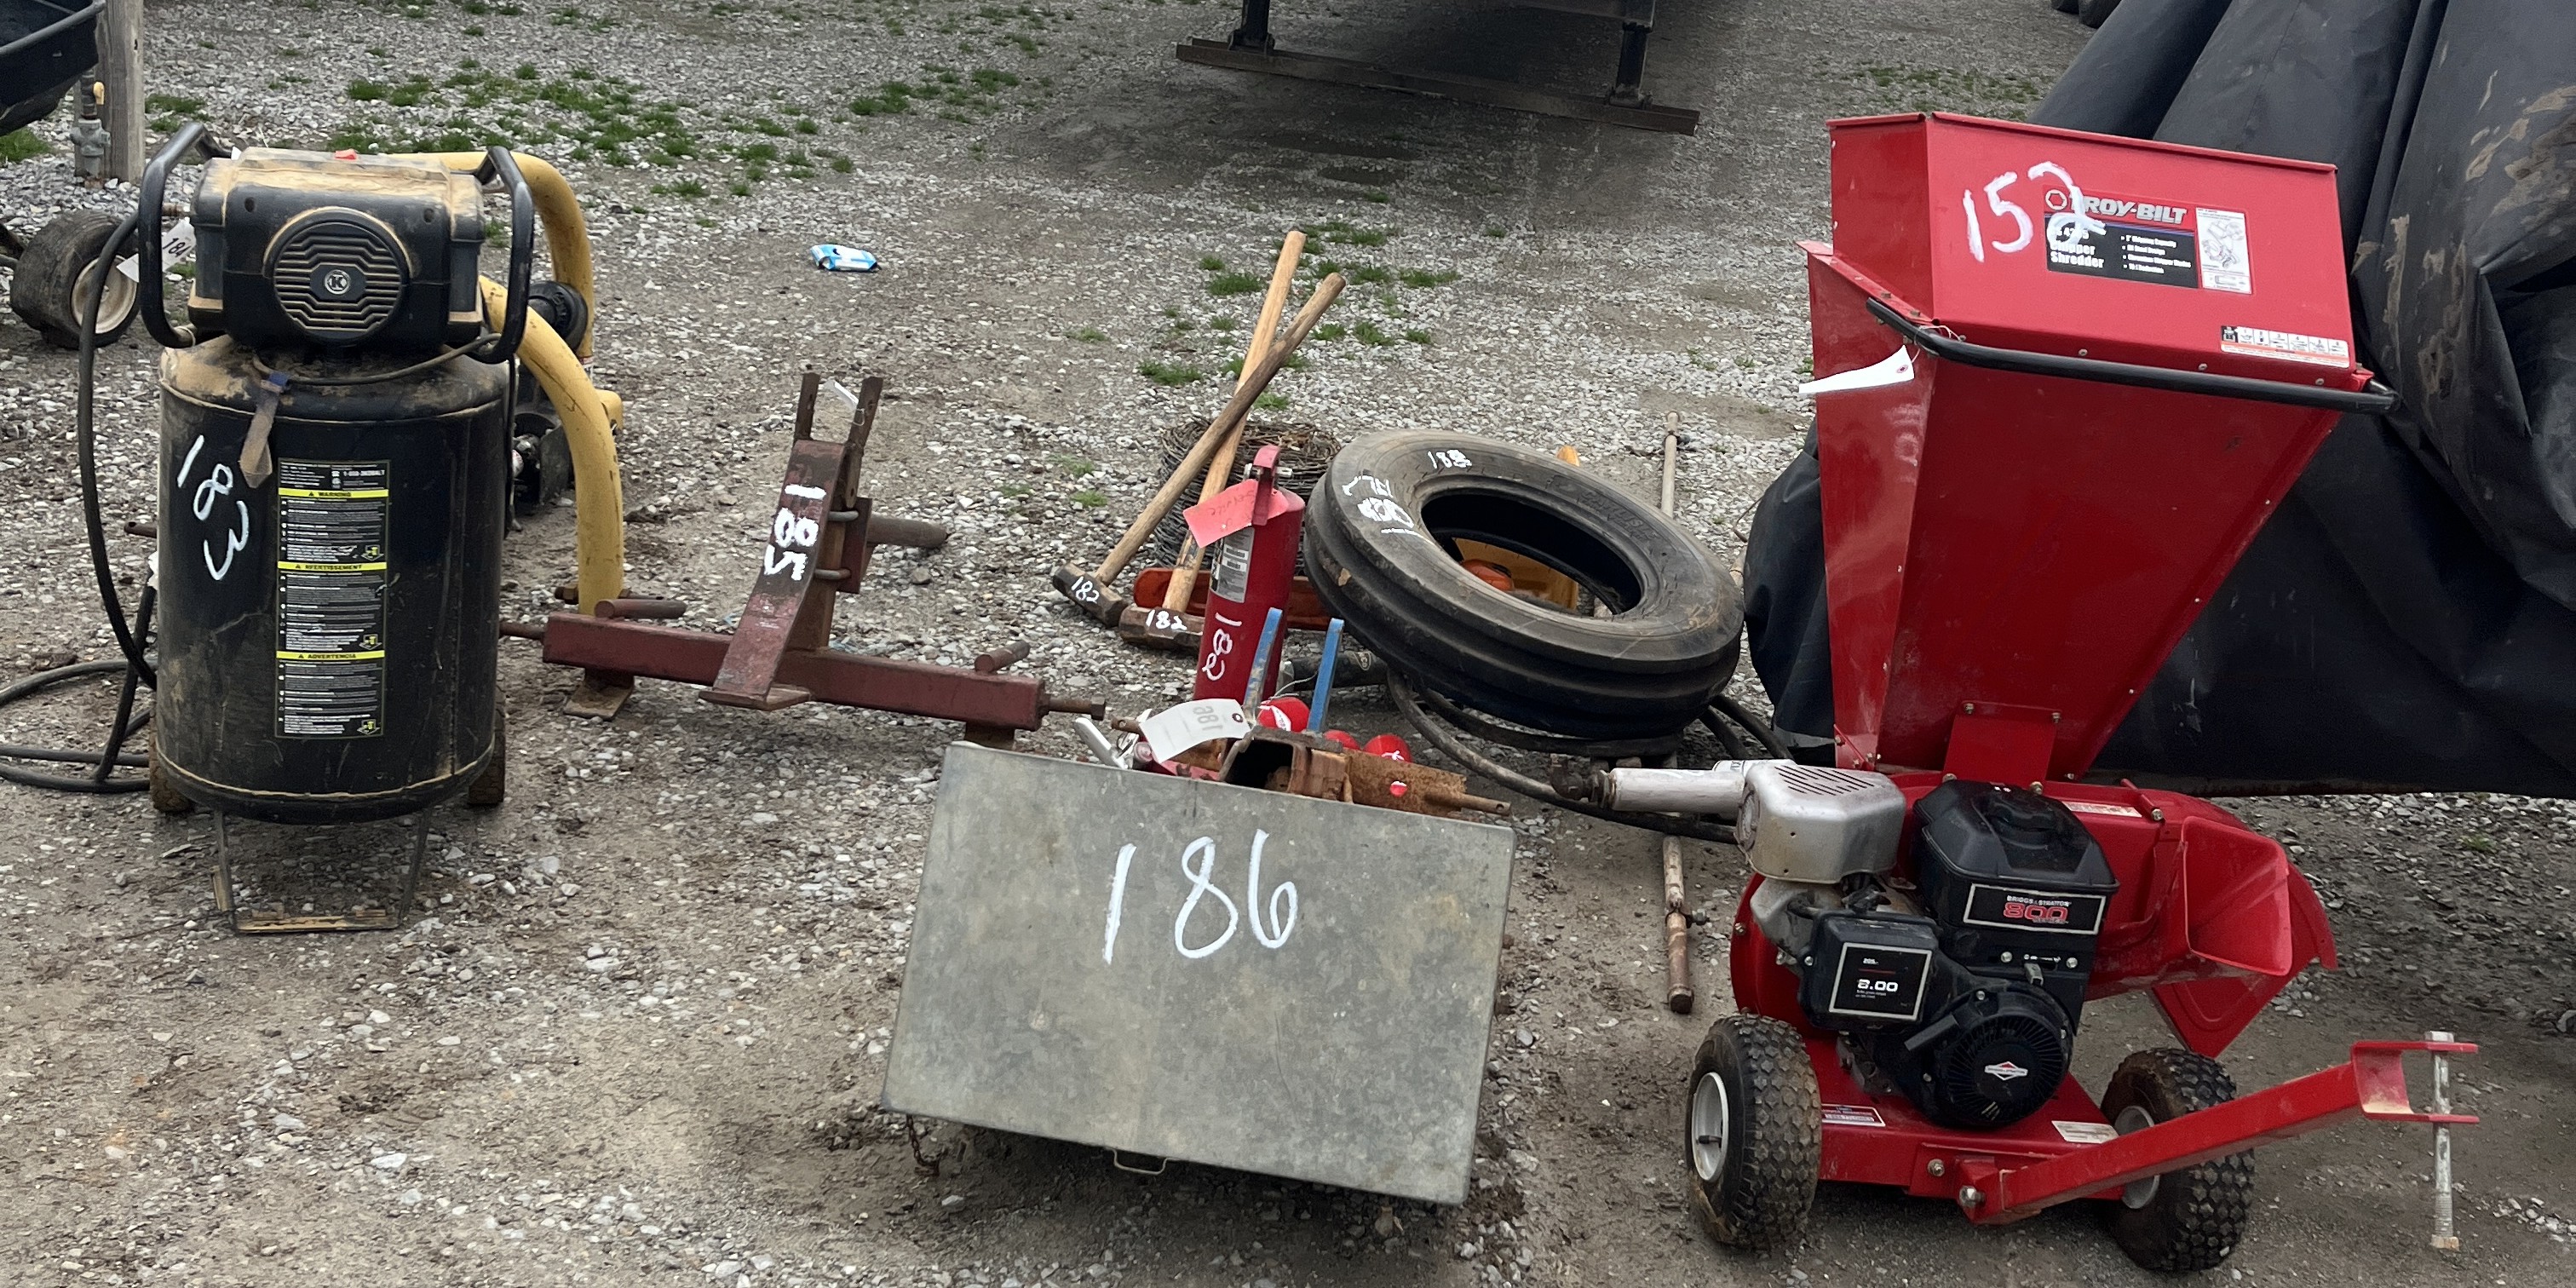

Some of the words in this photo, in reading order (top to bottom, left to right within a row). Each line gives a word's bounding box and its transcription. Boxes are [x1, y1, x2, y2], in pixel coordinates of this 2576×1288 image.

[1963, 161, 2106, 263] 152
[162, 238, 192, 258] 184
[2050, 251, 2105, 268] Shredder
[176, 434, 250, 581] 183
[763, 484, 826, 582] 185
[1071, 576, 1100, 604] 182
[1145, 609, 1187, 630] 182
[1202, 612, 1243, 681] 182
[1102, 828, 1298, 965] 186
[2006, 894, 2034, 905] BRIGGS
[2003, 902, 2068, 923] 800
[1857, 979, 1899, 992] 8.00
